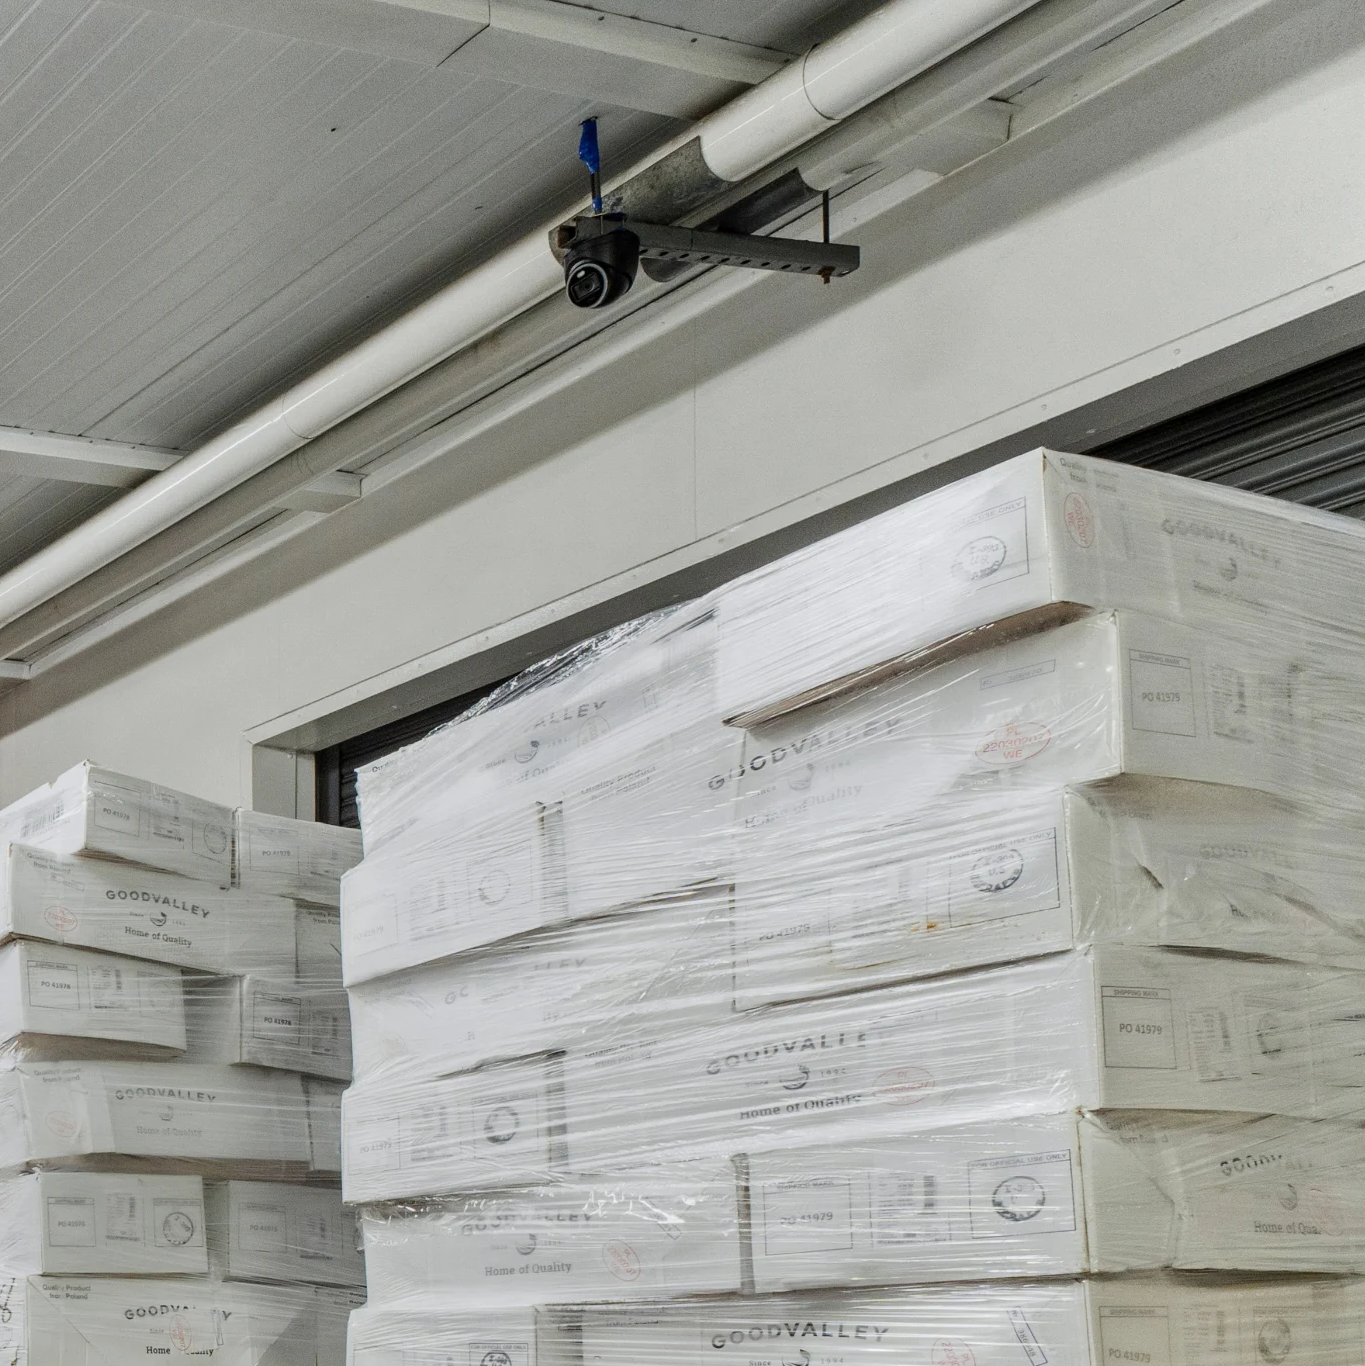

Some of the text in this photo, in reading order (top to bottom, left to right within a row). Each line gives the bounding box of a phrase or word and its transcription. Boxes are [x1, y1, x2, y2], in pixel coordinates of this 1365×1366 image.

[1141, 692, 1181, 703] PO 41979
[1002, 747, 1023, 758] WE
[106, 890, 210, 918] GOODVALLEY
[125, 926, 192, 947] Home of Quality
[275, 1018, 291, 1026] 41978
[1119, 1024, 1163, 1035] PO 41979
[115, 1087, 216, 1103] GOODVALLEY
[137, 1127, 202, 1138] Home Quality
[485, 1262, 572, 1276] Home of Quality
[711, 1320, 889, 1350] GOODVALLEY
[146, 1346, 171, 1354] Home
[1109, 1348, 1151, 1363] PO 41979
[749, 1359, 772, 1366] Since
